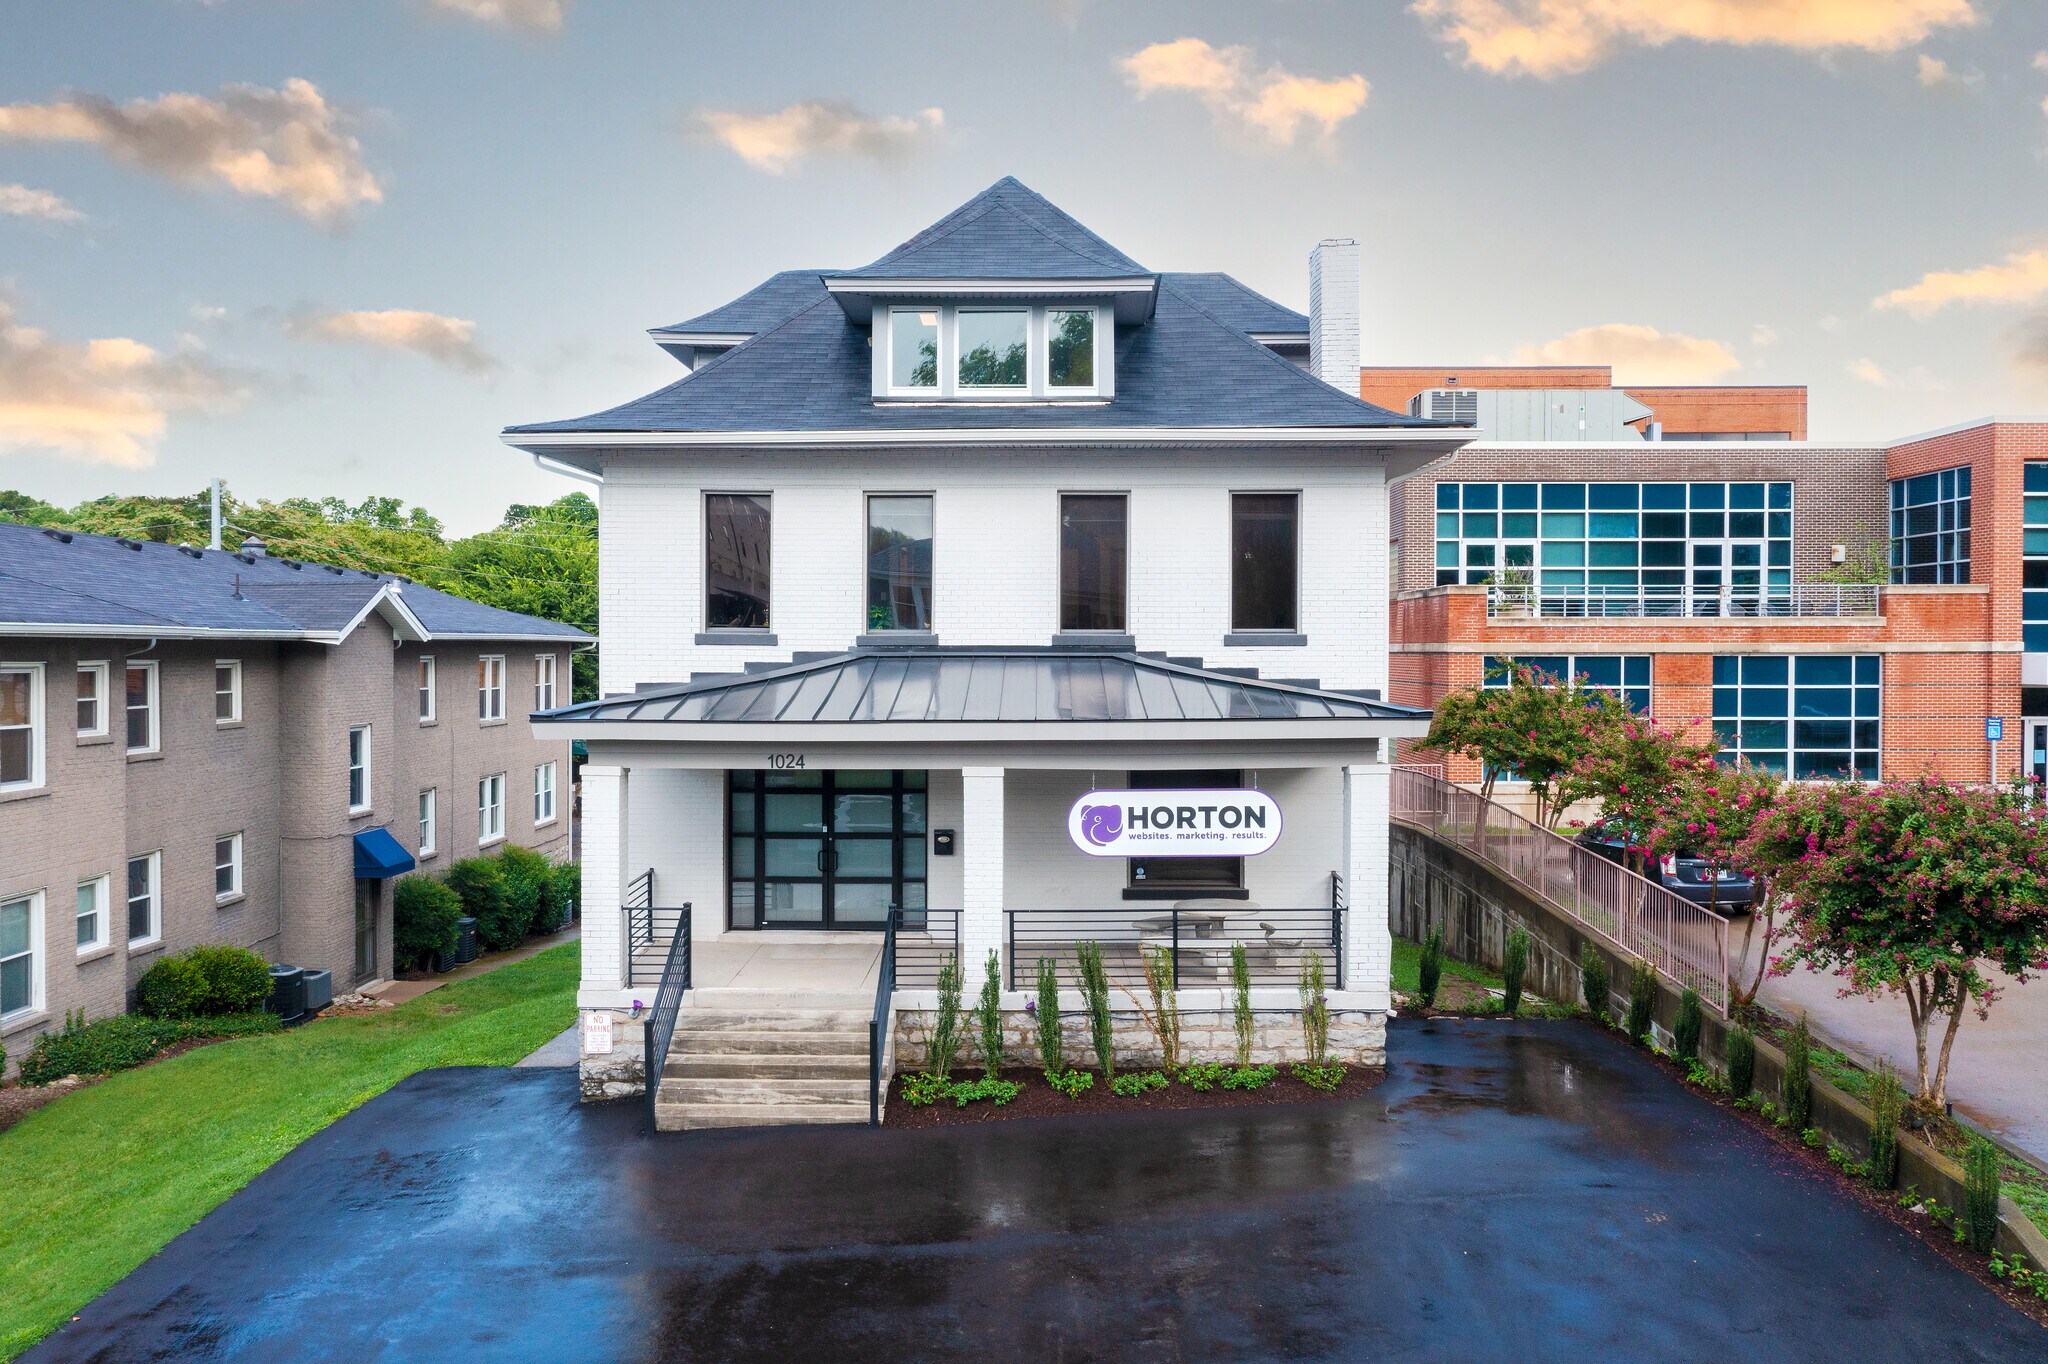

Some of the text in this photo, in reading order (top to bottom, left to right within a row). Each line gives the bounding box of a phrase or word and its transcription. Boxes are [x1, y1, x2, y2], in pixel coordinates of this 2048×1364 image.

[767, 753, 806, 769] 1024
[1128, 805, 1266, 829] HORTON
[1128, 831, 1267, 841] websites. marketing. results.
[593, 1015, 604, 1024] NO
[586, 1025, 610, 1033] PARKING
